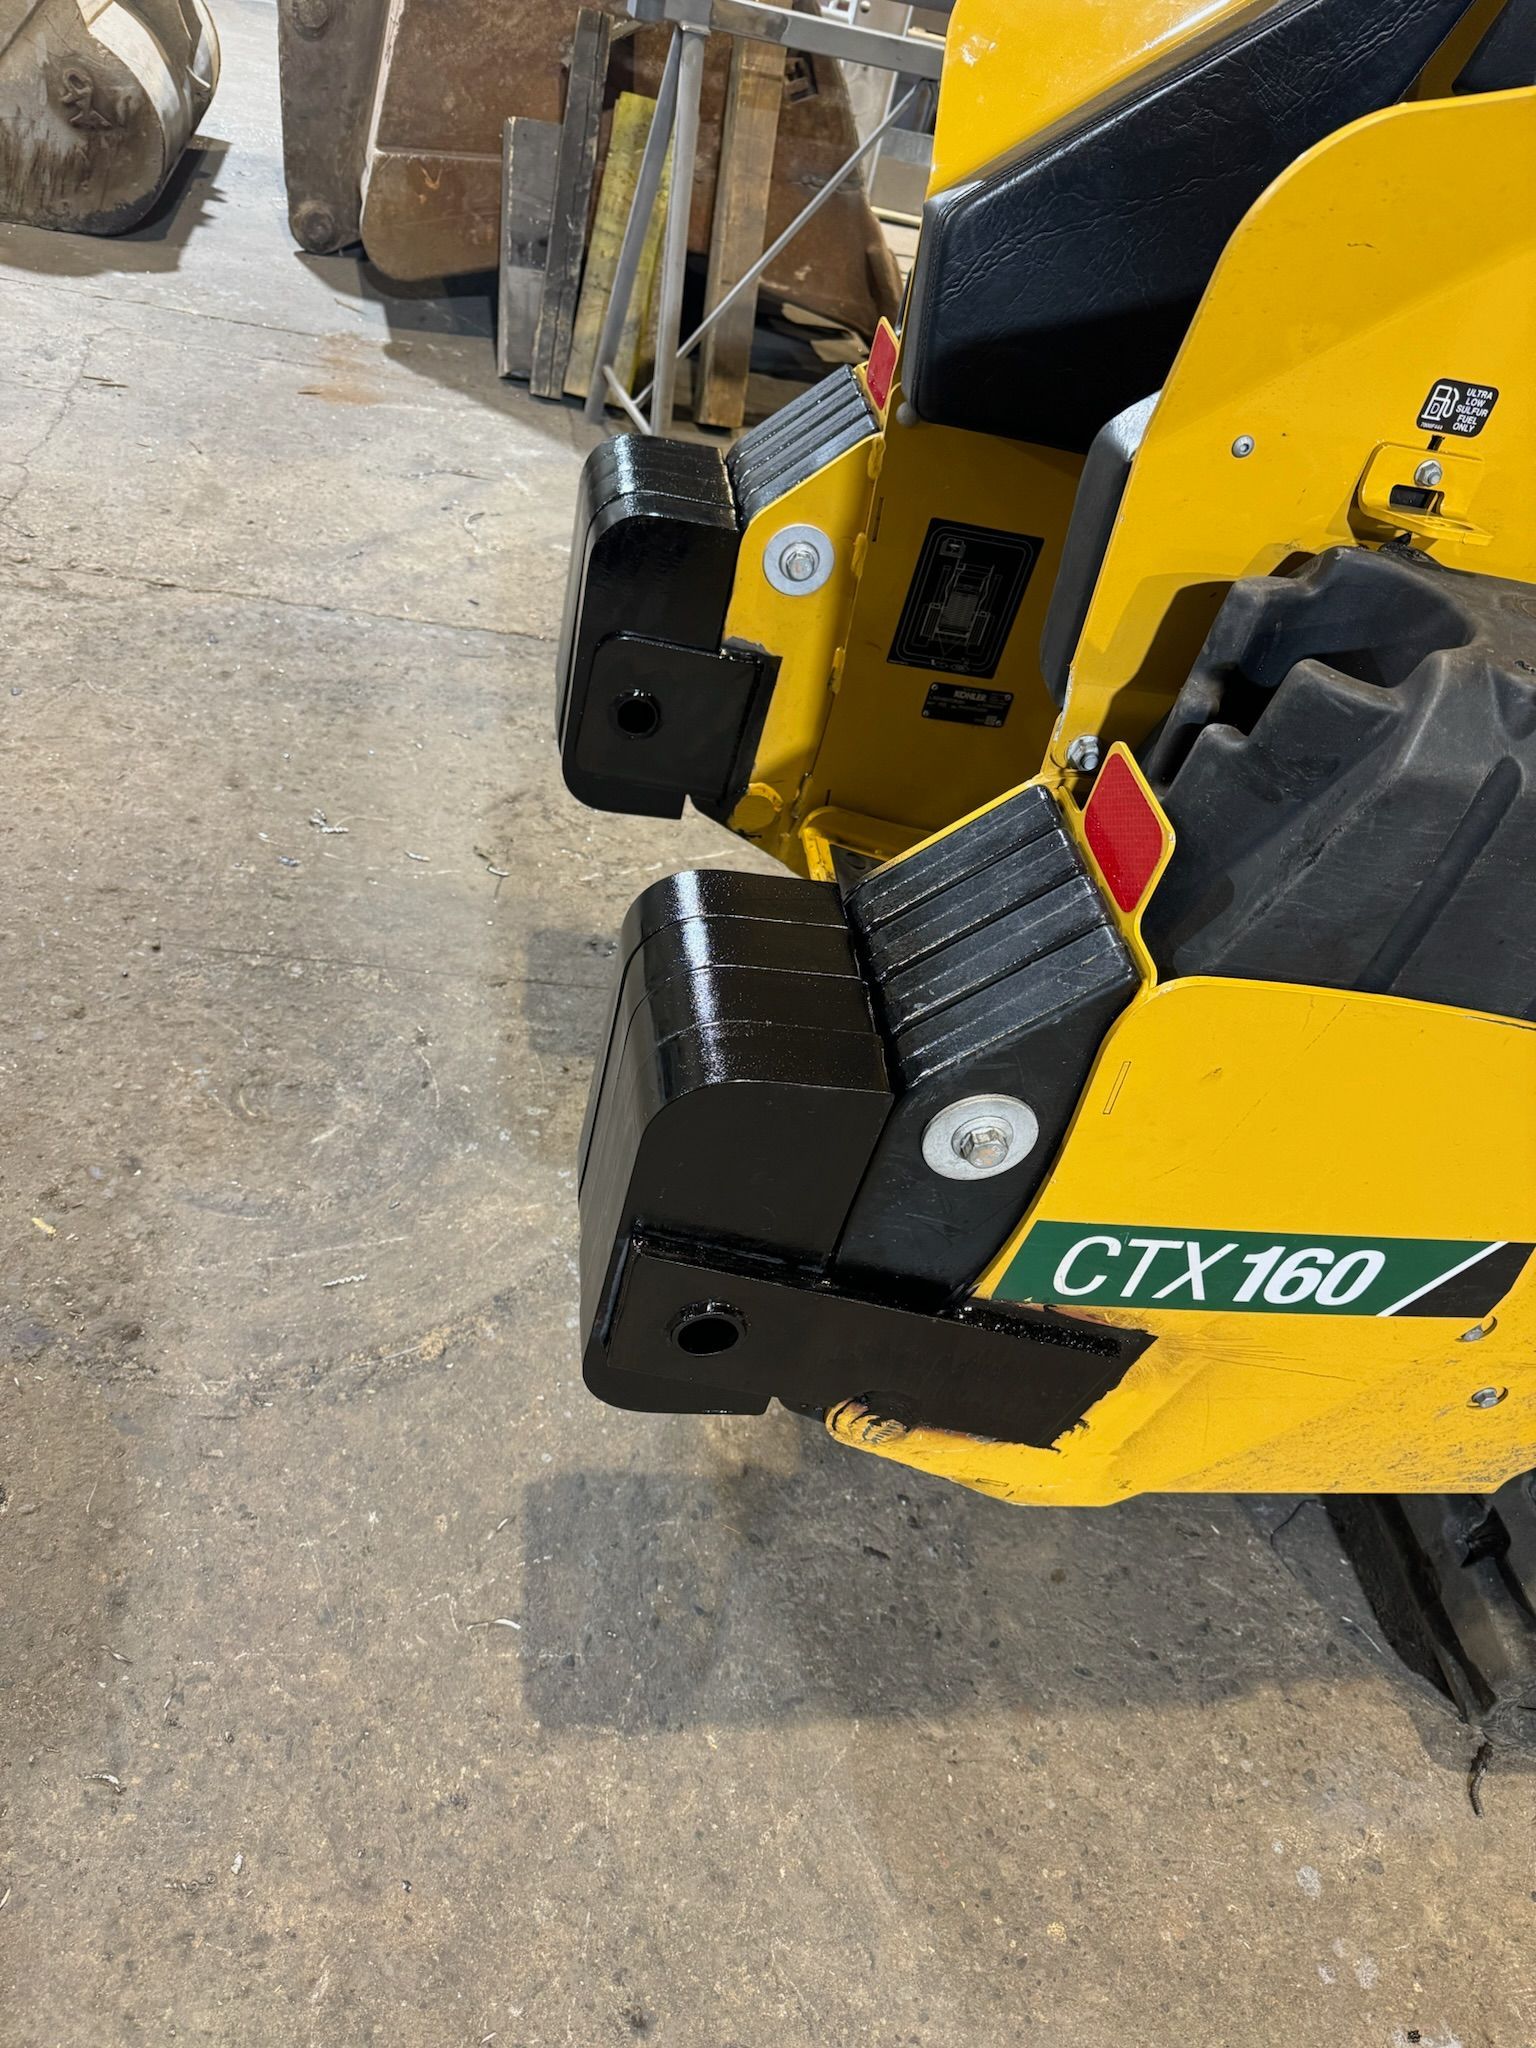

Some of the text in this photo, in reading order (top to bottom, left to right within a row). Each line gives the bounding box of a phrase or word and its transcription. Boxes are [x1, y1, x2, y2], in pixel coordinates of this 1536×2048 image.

[1466, 388, 1493, 400] ULTRA
[1465, 398, 1486, 407] LOW
[1456, 404, 1489, 417] SULFUR
[1457, 416, 1477, 425] FUEL
[1452, 422, 1475, 433] ONLY
